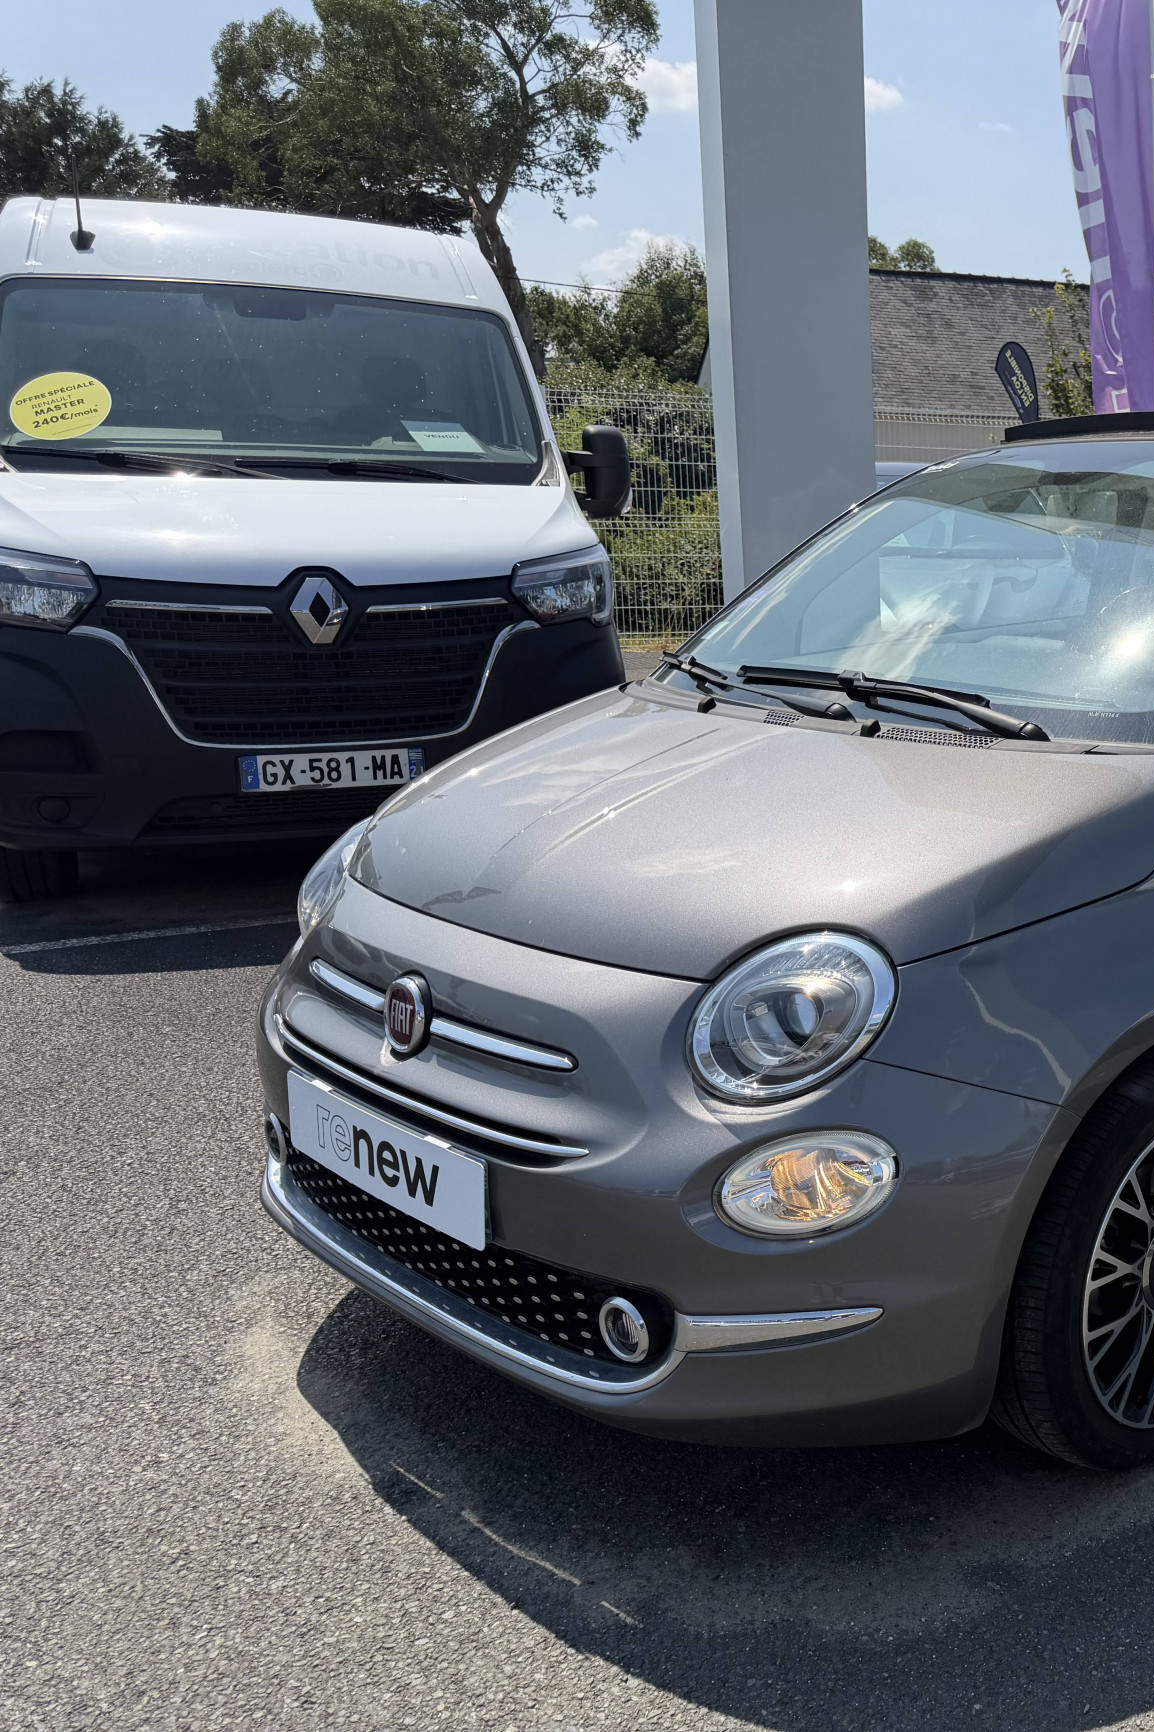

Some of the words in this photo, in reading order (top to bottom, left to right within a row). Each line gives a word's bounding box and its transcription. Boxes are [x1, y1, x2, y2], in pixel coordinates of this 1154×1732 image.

[15, 392, 47, 406] OFFRE
[48, 381, 94, 397] SPÉCIALE
[31, 394, 73, 410] RENAULT
[34, 398, 85, 417] MASTER
[261, 753, 404, 787] GX-581-MA
[390, 998, 414, 1036] FIAT
[316, 1103, 440, 1208] renew
